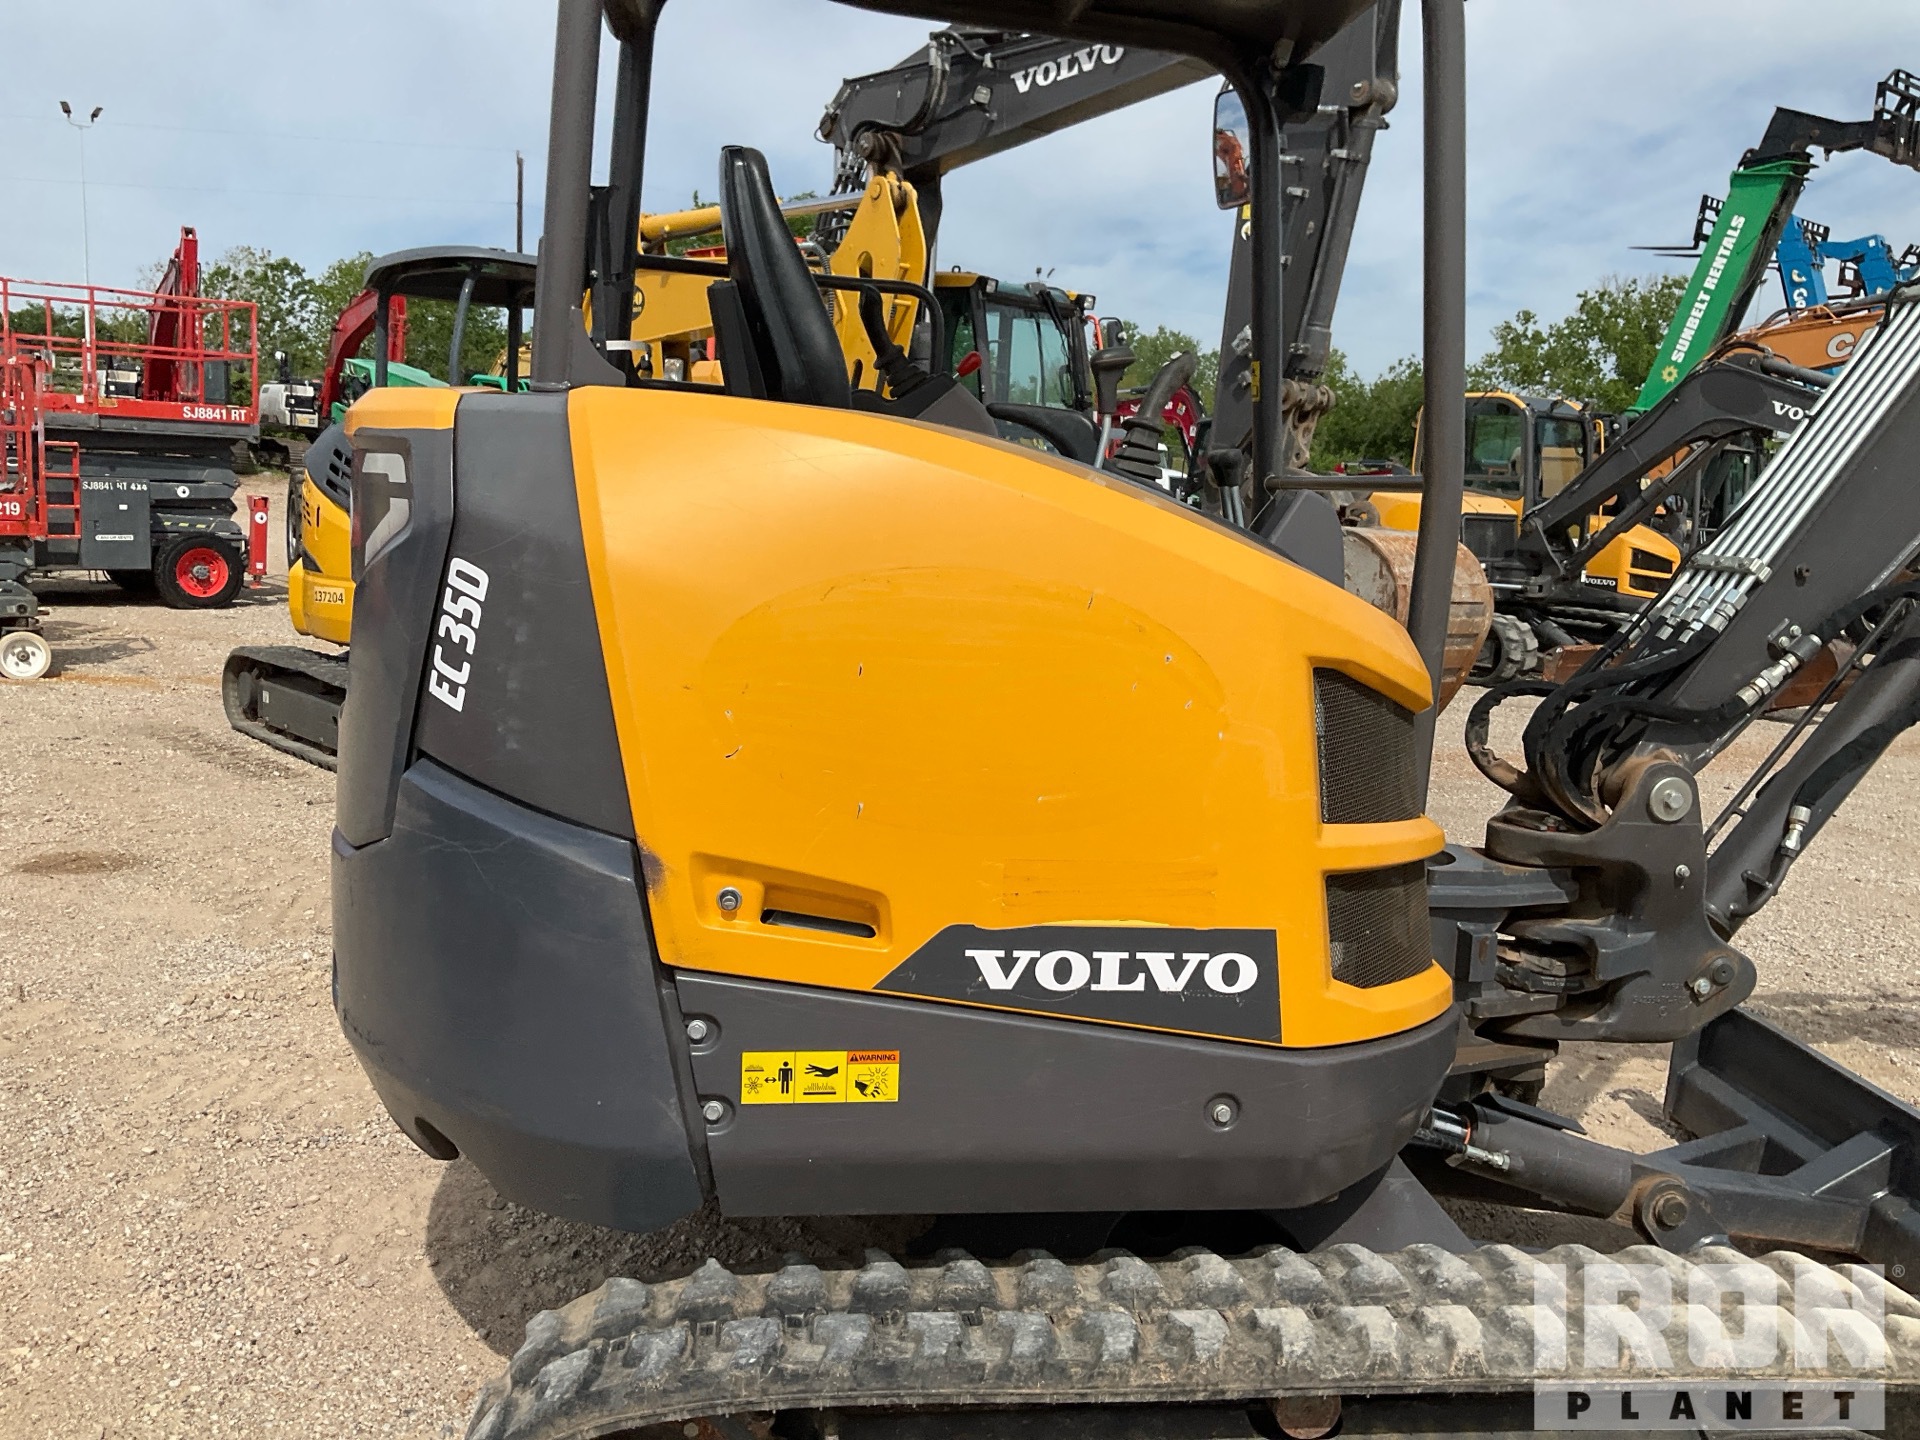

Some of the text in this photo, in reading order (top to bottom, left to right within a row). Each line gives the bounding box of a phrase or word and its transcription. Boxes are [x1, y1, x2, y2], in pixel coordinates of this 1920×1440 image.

[1010, 43, 1124, 93] VOLVO
[1670, 214, 1746, 363] SUNBELT RENTALS
[183, 406, 247, 421] SJ8841 RT
[1585, 577, 1616, 586] VOLVO
[314, 590, 344, 604] 137204
[965, 949, 1258, 993] VOLVO
